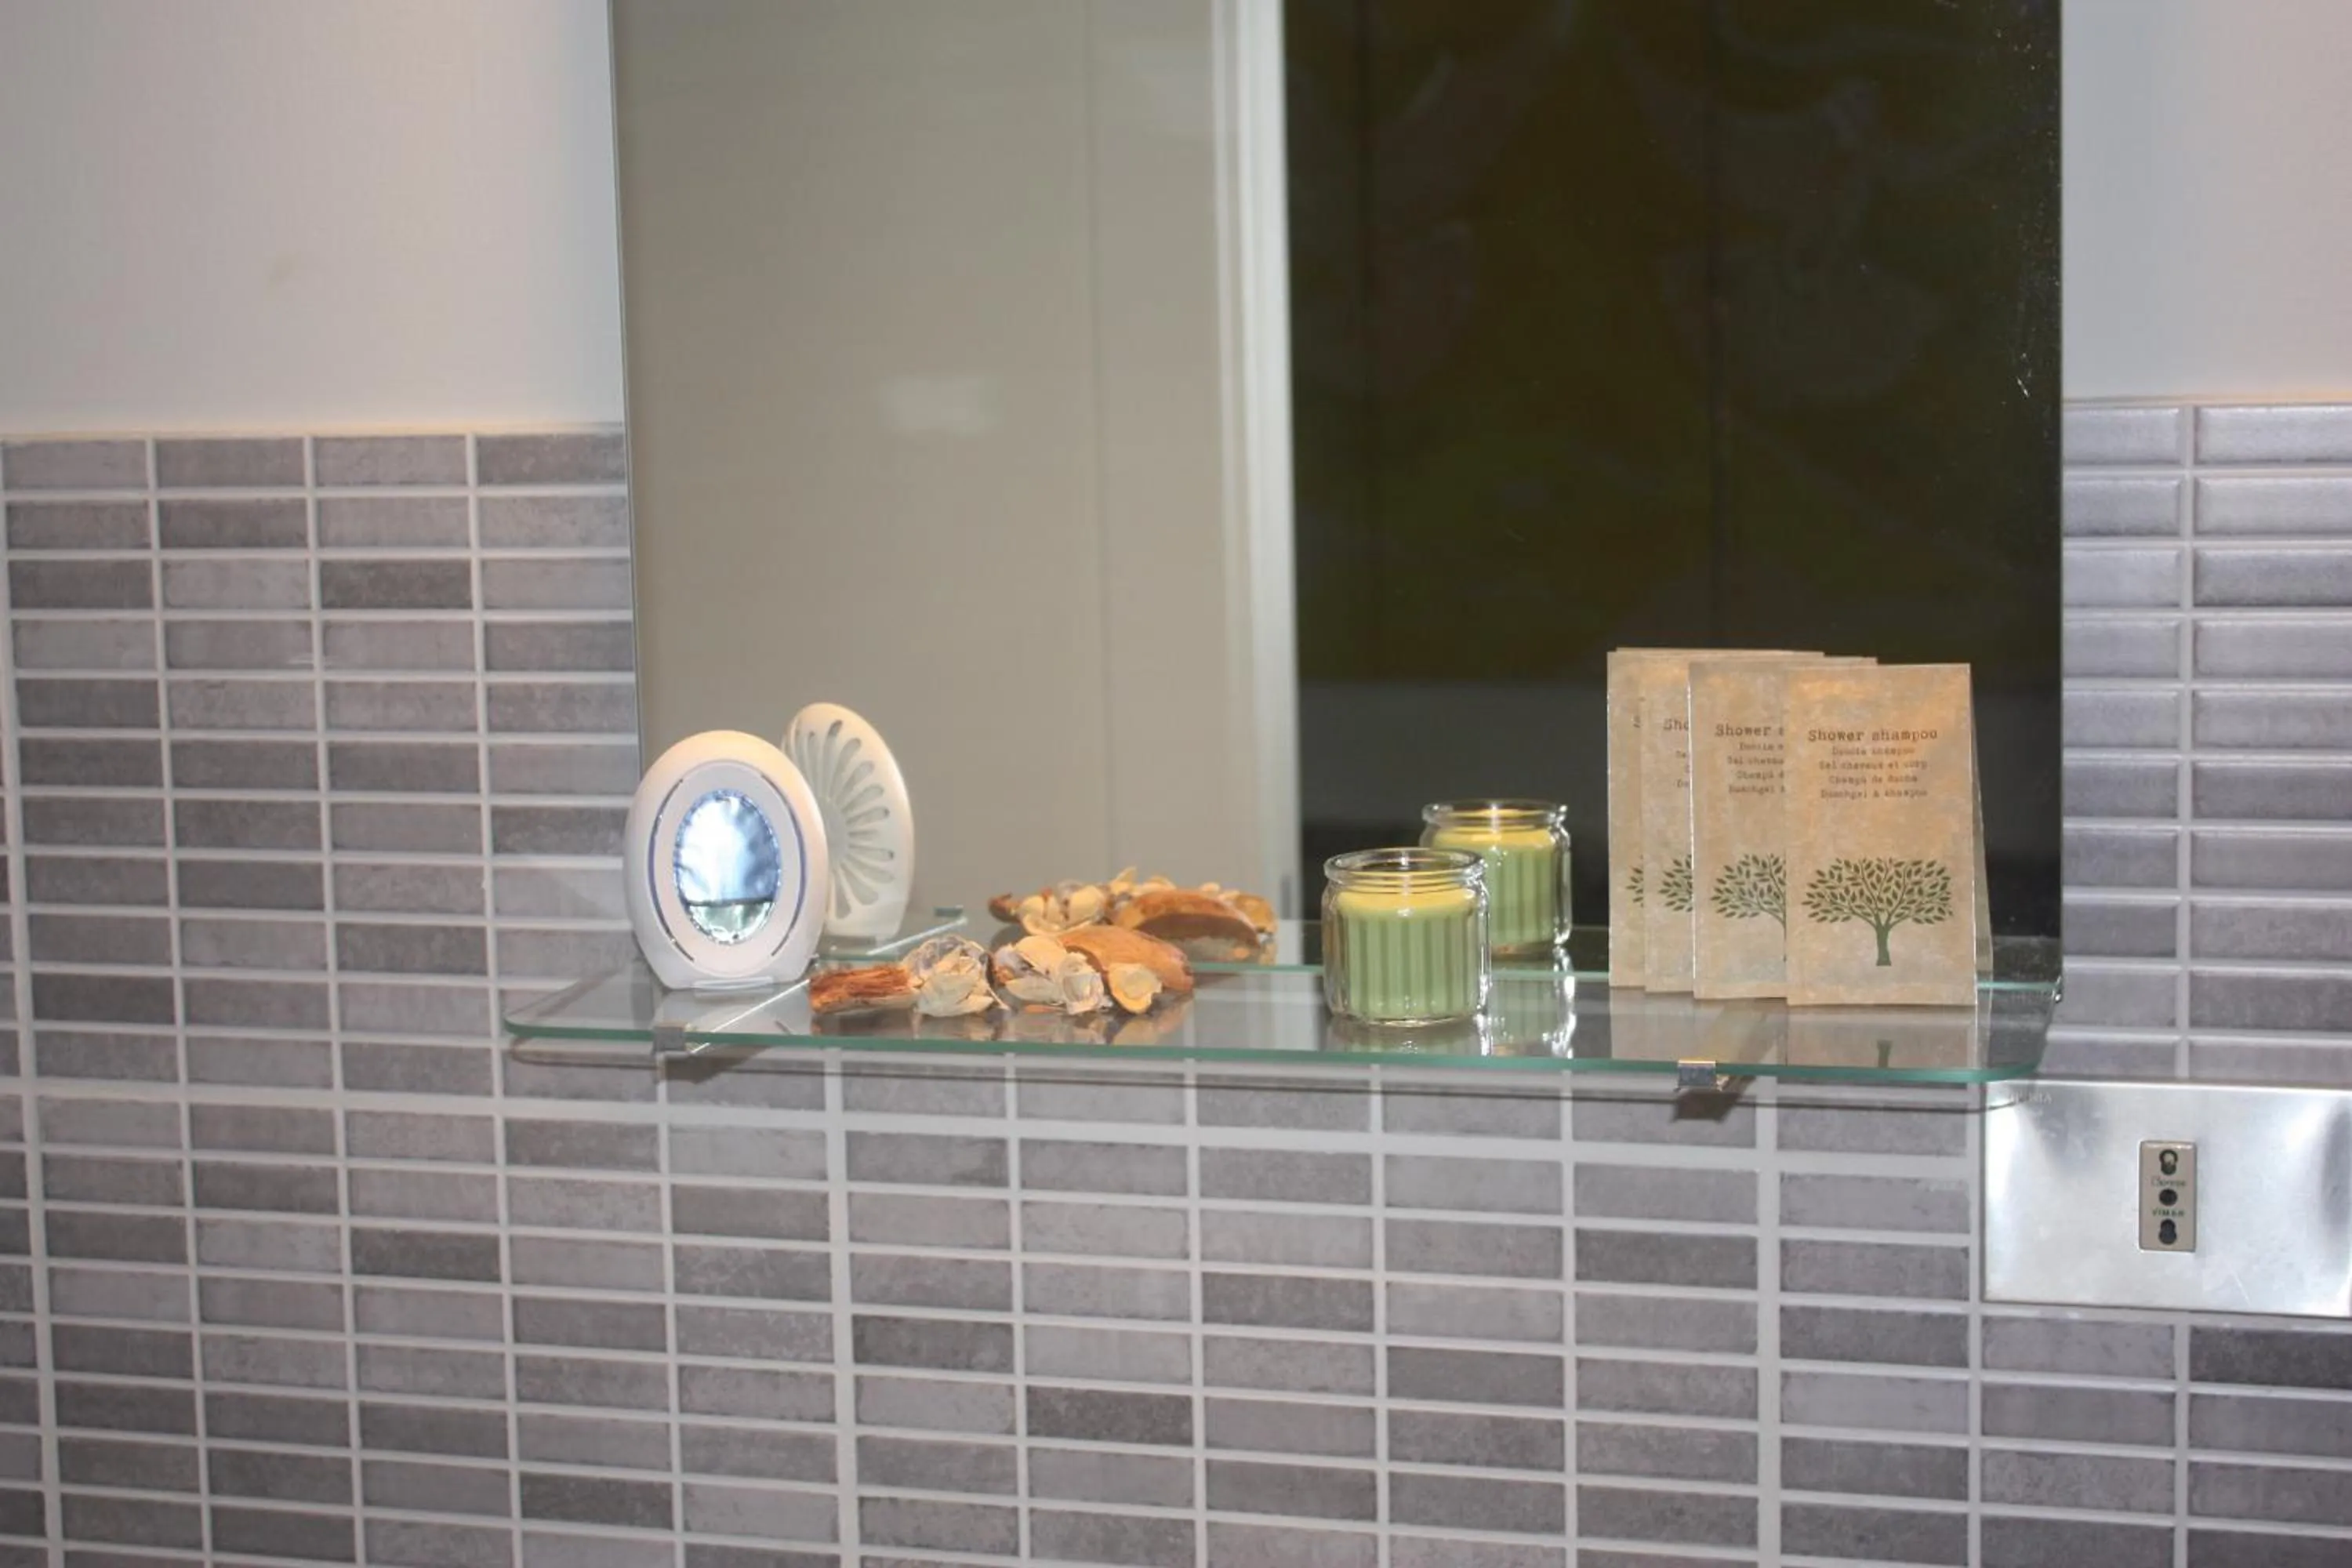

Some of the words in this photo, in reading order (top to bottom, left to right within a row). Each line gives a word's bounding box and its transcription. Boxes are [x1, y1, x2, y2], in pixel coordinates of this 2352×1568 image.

[1714, 723, 1772, 738] Shower
[1807, 728, 1864, 742] Shower
[1871, 728, 1937, 743] shampoo
